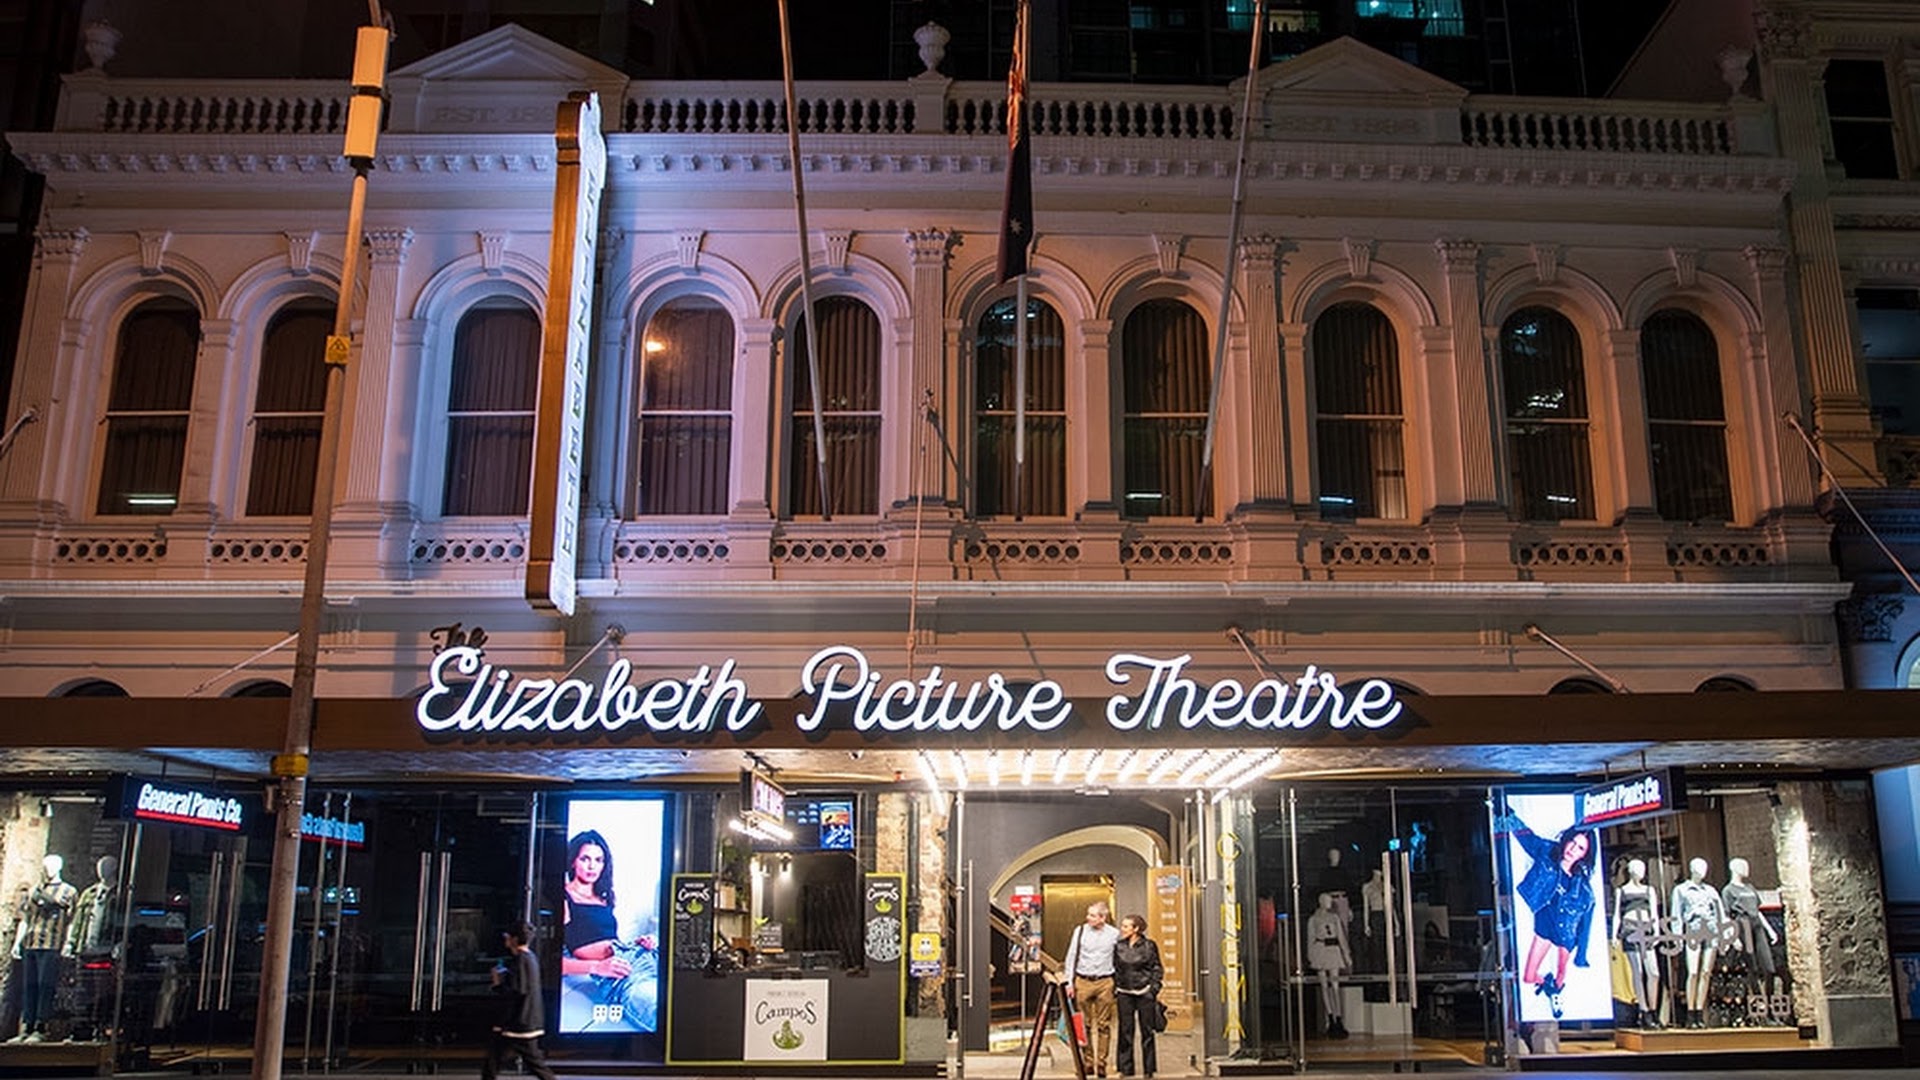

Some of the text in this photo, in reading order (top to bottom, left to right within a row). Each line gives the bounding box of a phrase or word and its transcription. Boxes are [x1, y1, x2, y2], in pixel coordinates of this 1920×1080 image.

[430, 622, 489, 657] The
[418, 645, 1402, 732] Elizabeth Picture Theatre
[138, 783, 193, 817] General
[192, 791, 226, 821] Pants
